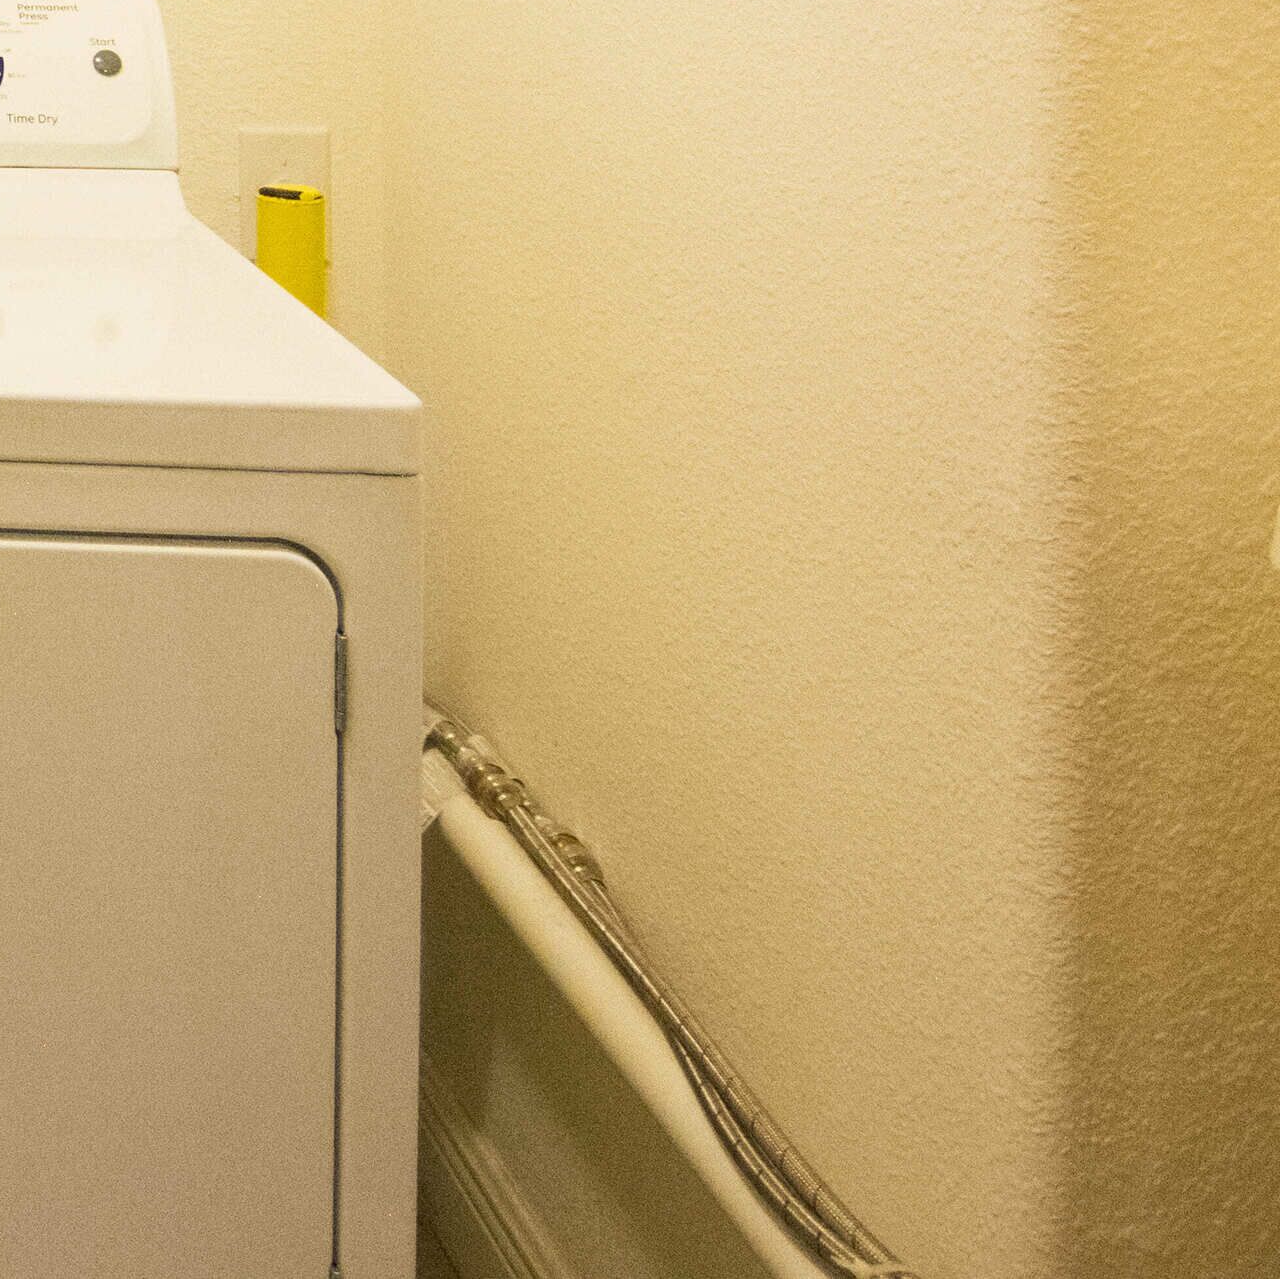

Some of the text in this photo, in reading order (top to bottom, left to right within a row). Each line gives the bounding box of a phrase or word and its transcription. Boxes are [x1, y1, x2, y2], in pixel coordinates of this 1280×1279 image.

[16, 3, 78, 13] Permanent
[18, 12, 48, 21] Press
[89, 37, 116, 47] Start
[6, 113, 59, 126] Time Dry
